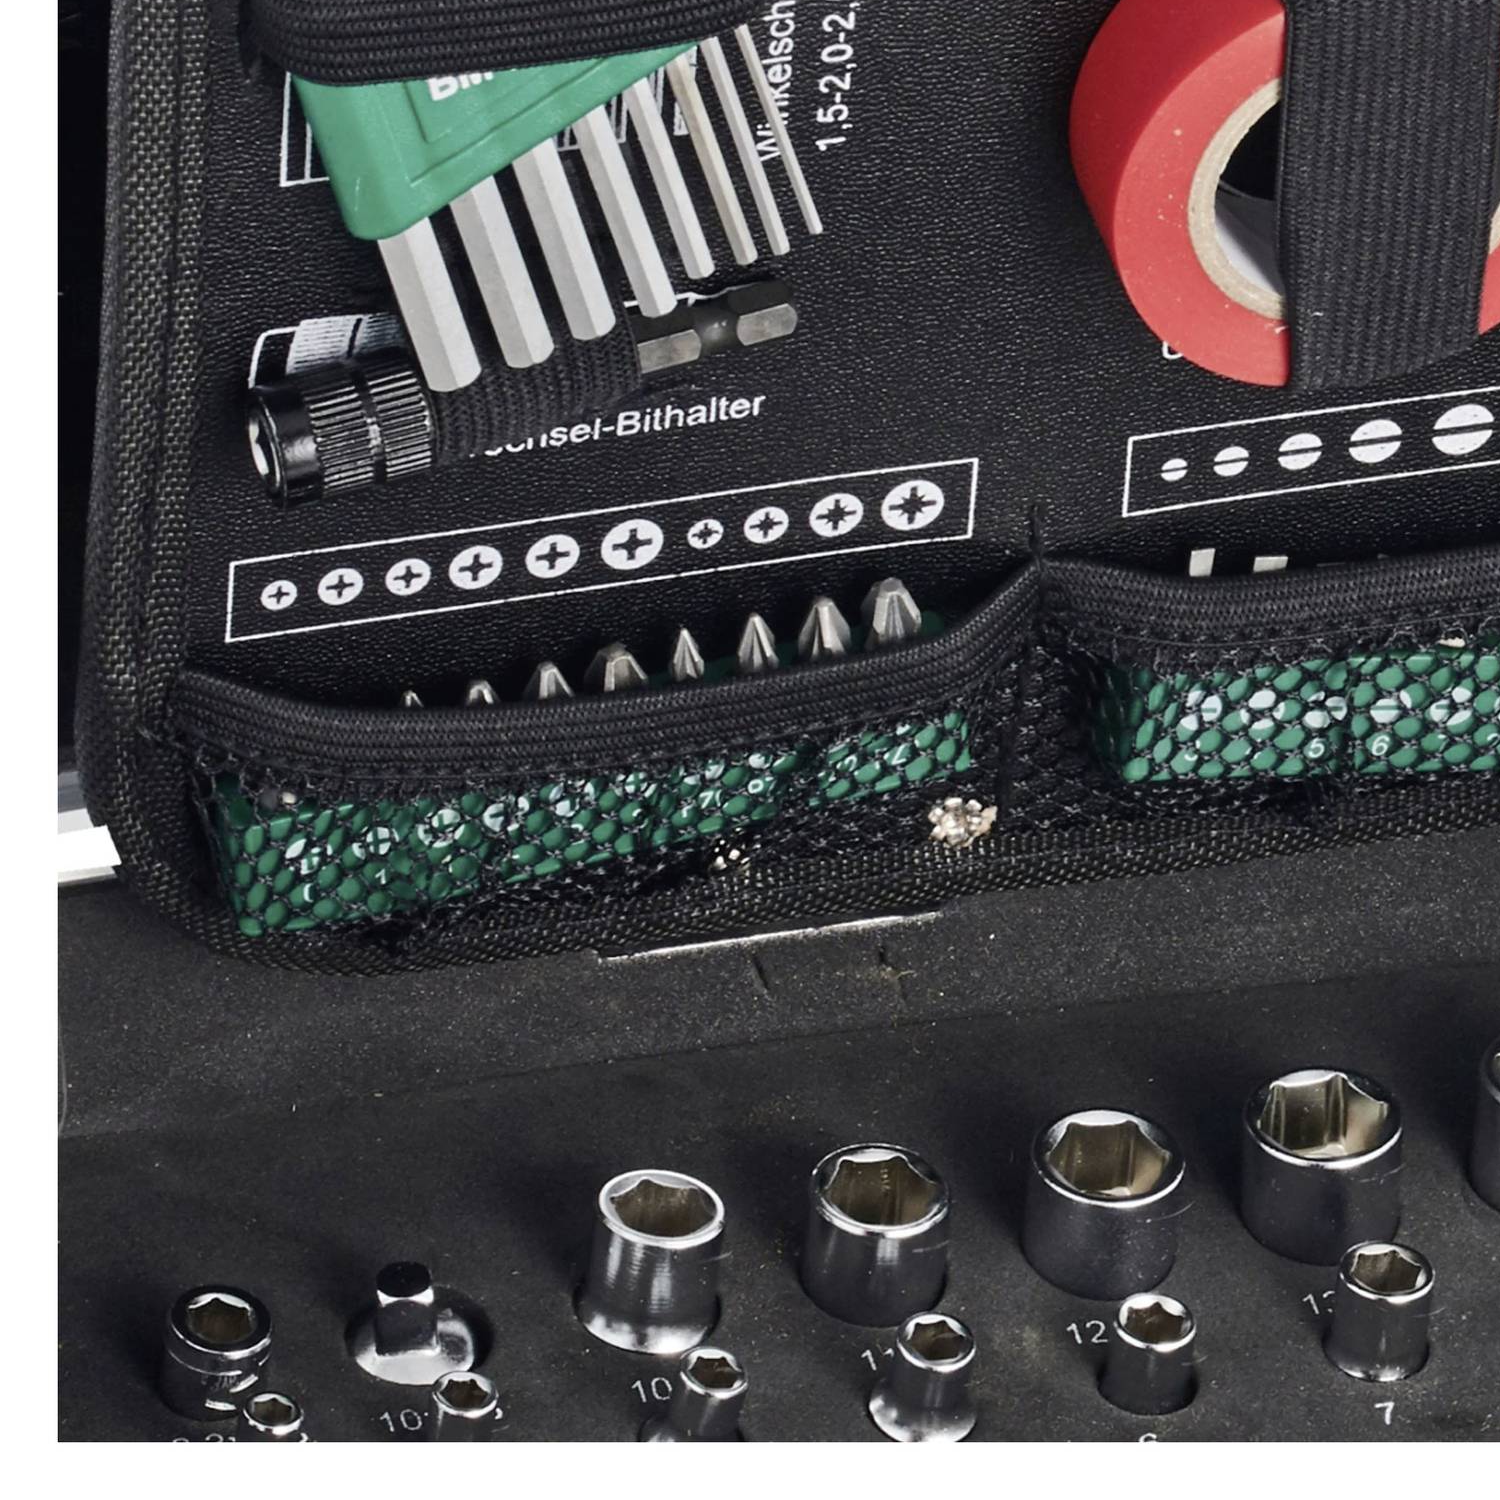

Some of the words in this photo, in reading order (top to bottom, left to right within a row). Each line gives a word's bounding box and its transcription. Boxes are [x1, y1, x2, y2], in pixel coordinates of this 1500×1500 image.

[1371, 735, 1391, 756] 6
[1066, 1320, 1108, 1344] 12
[631, 1376, 672, 1402] 10
[1374, 1401, 1395, 1425] 7
